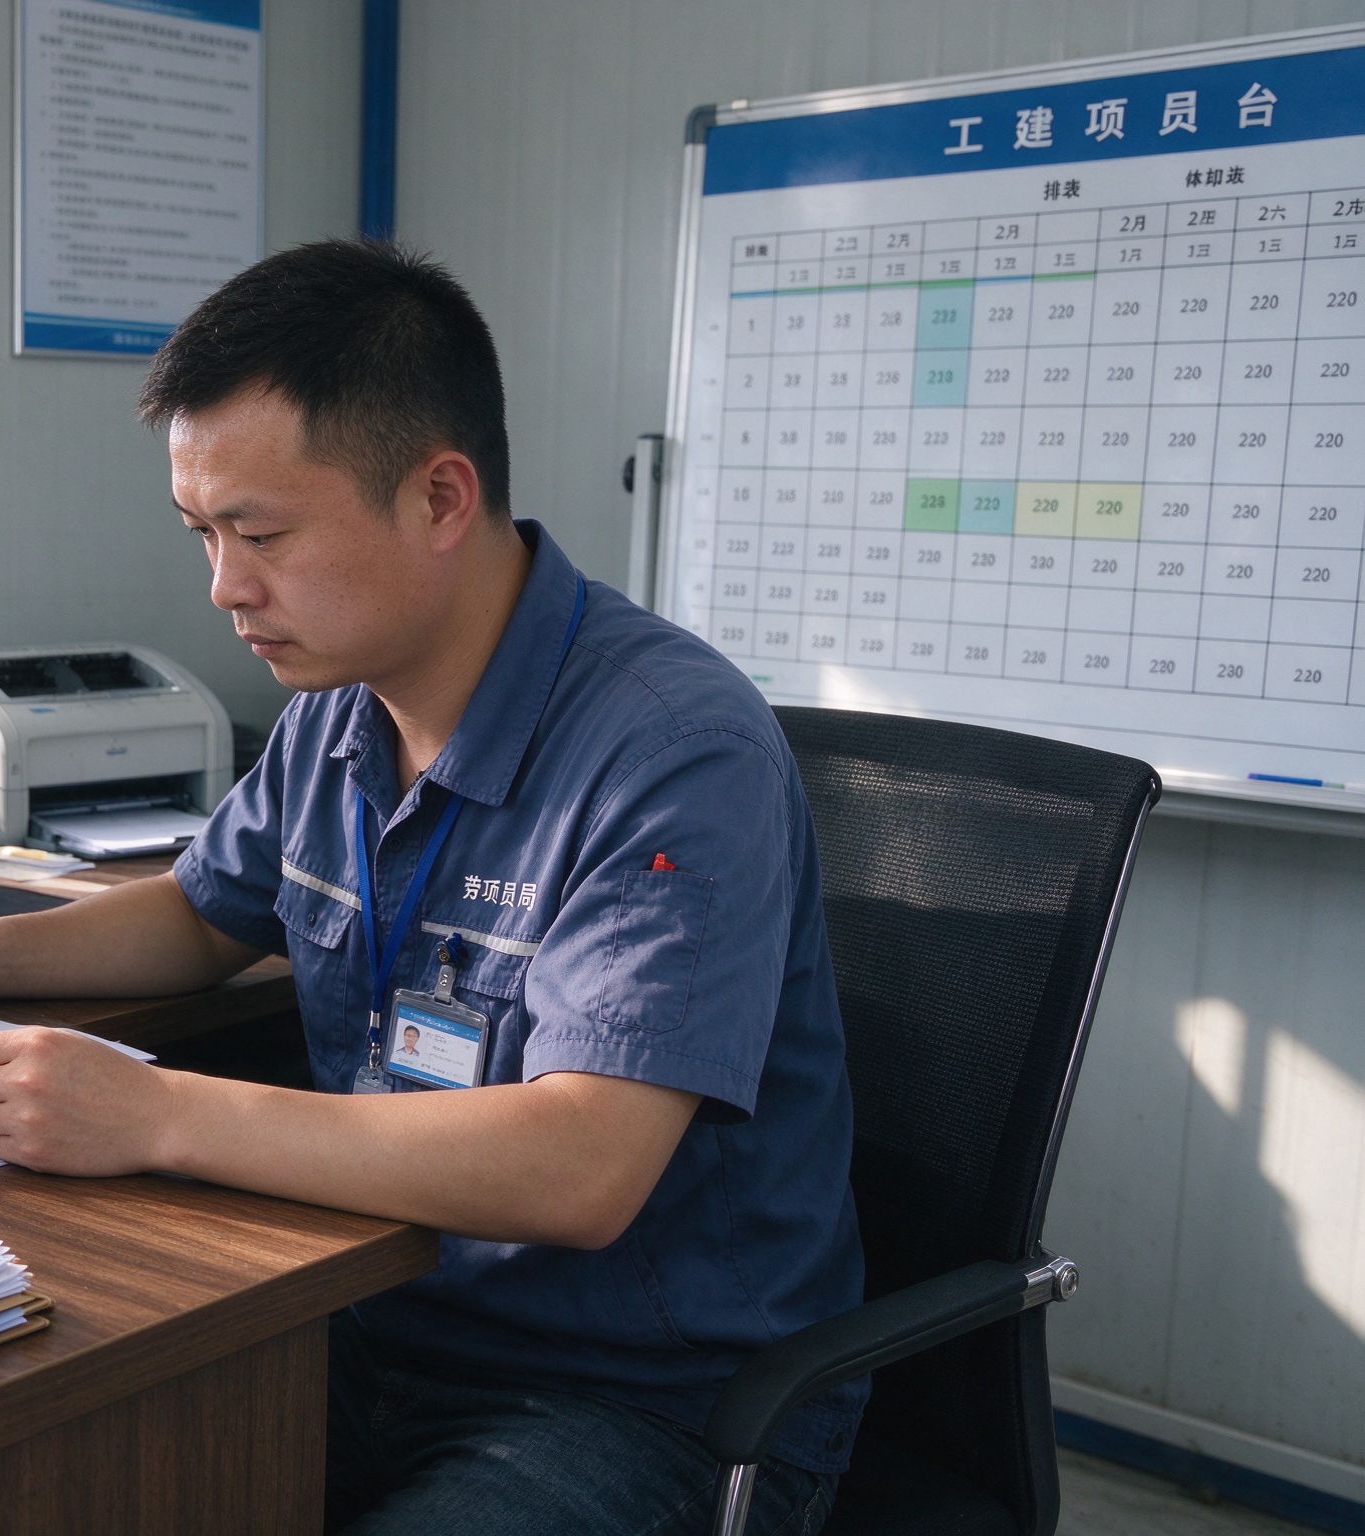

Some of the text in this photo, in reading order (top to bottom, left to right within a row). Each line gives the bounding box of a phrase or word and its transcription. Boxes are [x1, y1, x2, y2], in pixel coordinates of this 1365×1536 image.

[943, 82, 1278, 156] 工建项员台
[994, 224, 1020, 240] 2月
[1119, 215, 1147, 232] 2月
[1112, 302, 1139, 316] 220
[1249, 294, 1279, 311] 220
[1326, 291, 1357, 308] 220
[1106, 367, 1135, 381] 220
[1173, 366, 1202, 381] 220
[1243, 364, 1273, 380] 220
[1320, 362, 1350, 378] 220
[1101, 432, 1130, 447] 220
[1167, 432, 1196, 448] 220
[1238, 432, 1267, 448] 220
[1314, 433, 1344, 449] 220
[1095, 500, 1123, 515] 220
[1091, 559, 1118, 574] 220
[1157, 562, 1185, 577] 220
[1225, 564, 1254, 580] 220
[1302, 567, 1331, 583] 220
[1292, 669, 1322, 684] 220
[462, 874, 537, 911] 劳项员局
